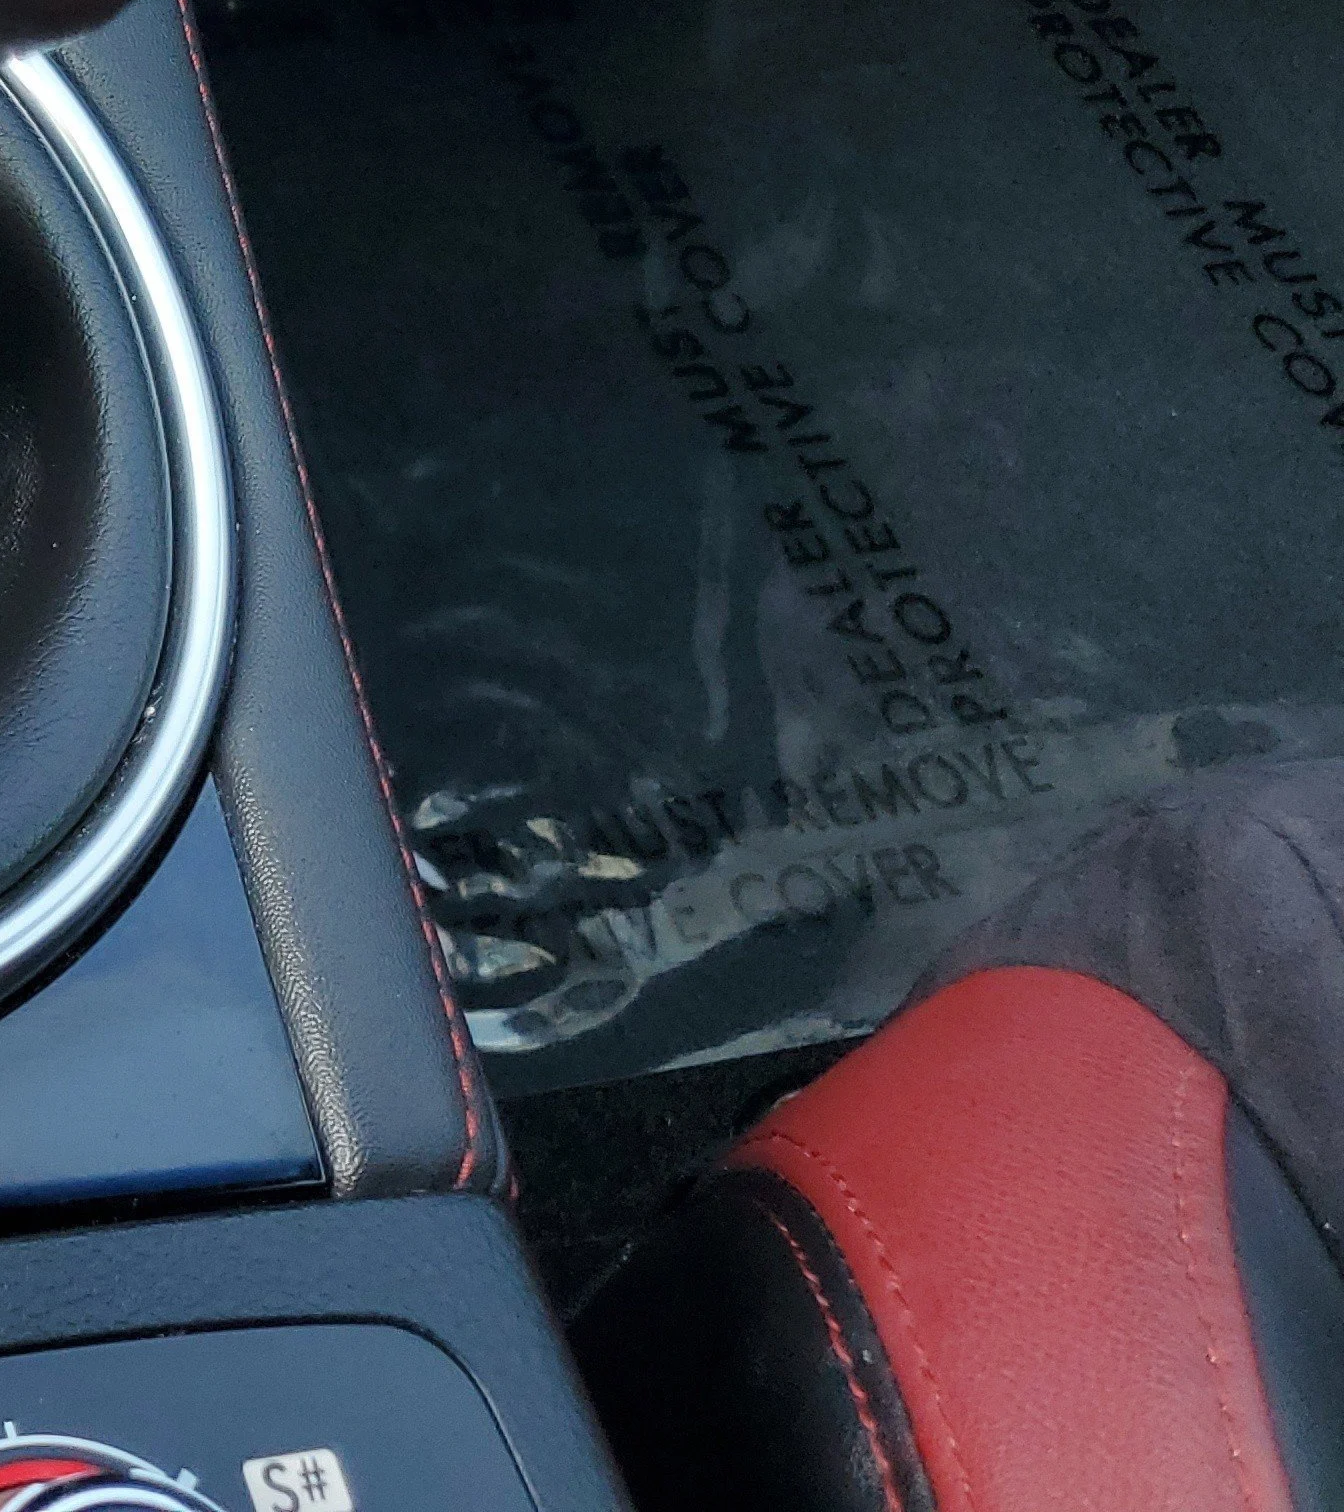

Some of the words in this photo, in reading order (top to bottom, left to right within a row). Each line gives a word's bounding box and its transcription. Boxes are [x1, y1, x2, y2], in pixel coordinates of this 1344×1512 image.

[739, 361, 1012, 728] PROTECTIVE
[762, 499, 937, 736] DEALER
[787, 737, 1054, 835] REMOVE
[727, 842, 964, 919] COVER
